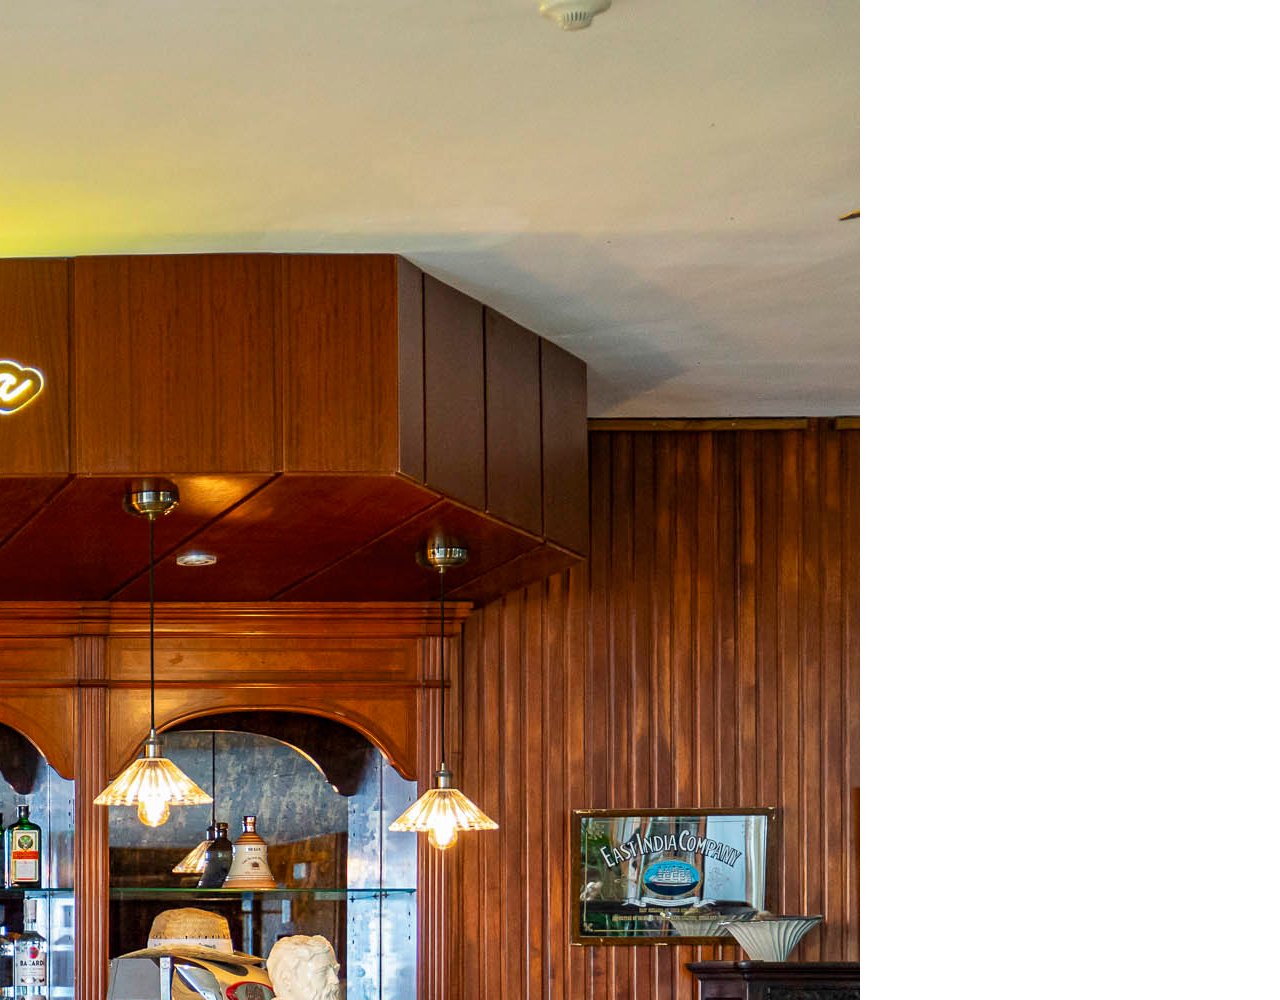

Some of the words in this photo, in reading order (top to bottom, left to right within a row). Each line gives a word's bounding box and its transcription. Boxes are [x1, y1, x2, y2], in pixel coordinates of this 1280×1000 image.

[600, 839, 637, 868] EAST
[635, 832, 678, 855] INDIA
[679, 830, 742, 868] COMPANY
